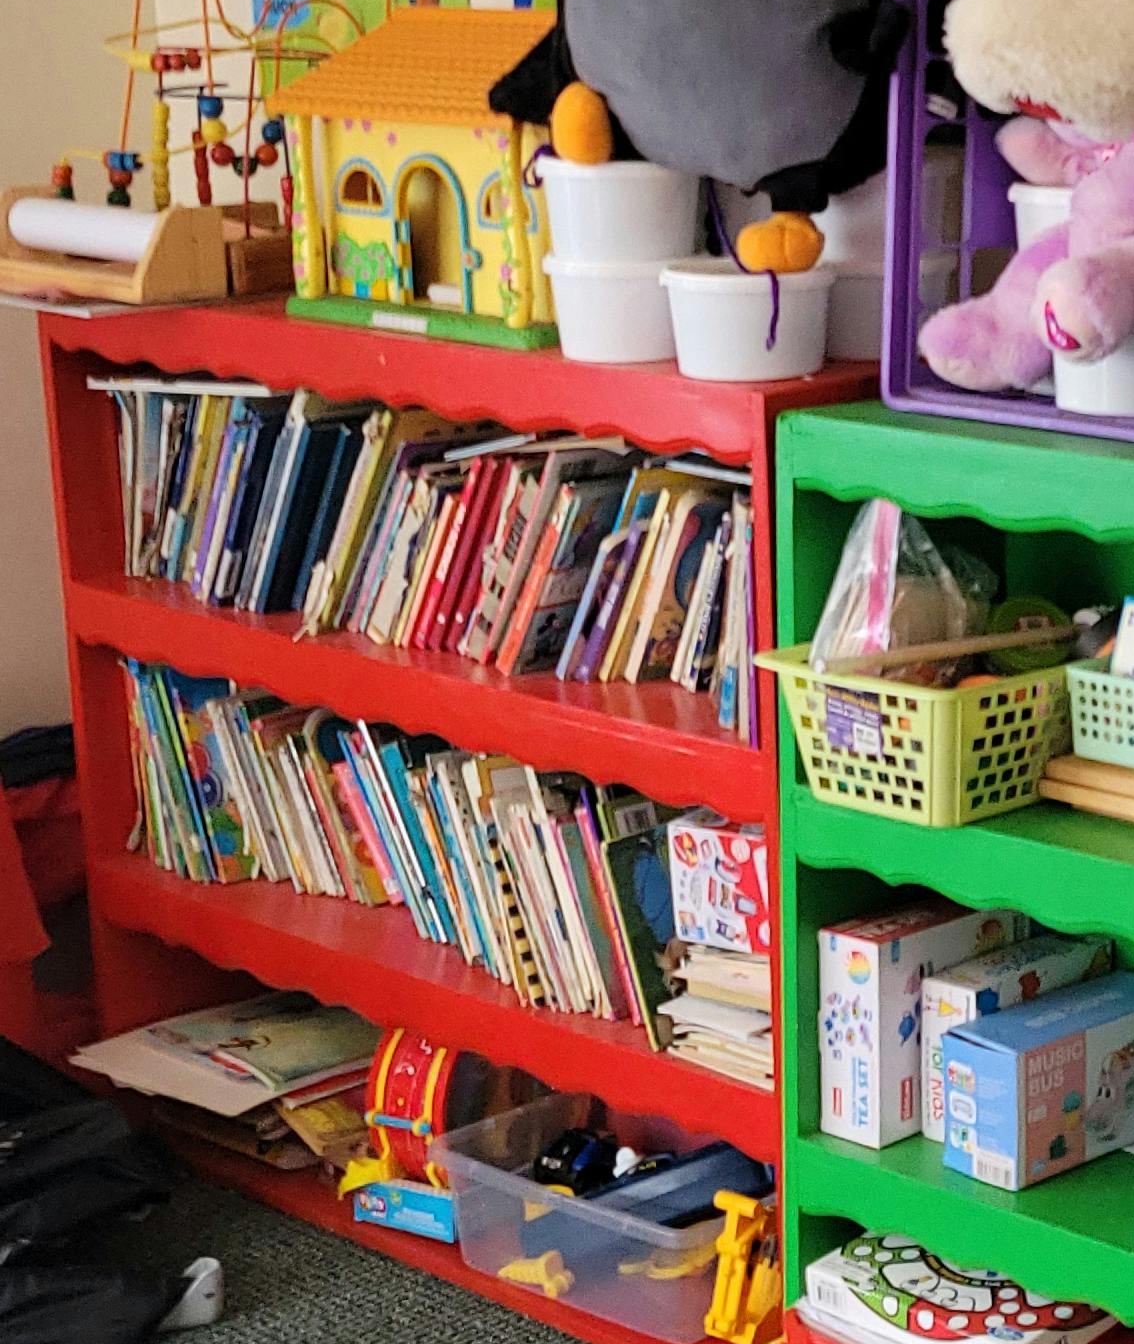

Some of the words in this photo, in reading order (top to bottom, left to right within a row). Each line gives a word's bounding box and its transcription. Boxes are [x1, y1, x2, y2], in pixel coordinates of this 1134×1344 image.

[857, 1058, 869, 1090] SET
[1027, 1040, 1083, 1078] MUSIC
[1027, 1068, 1065, 1098] BUS
[857, 1092, 869, 1128] TEA
